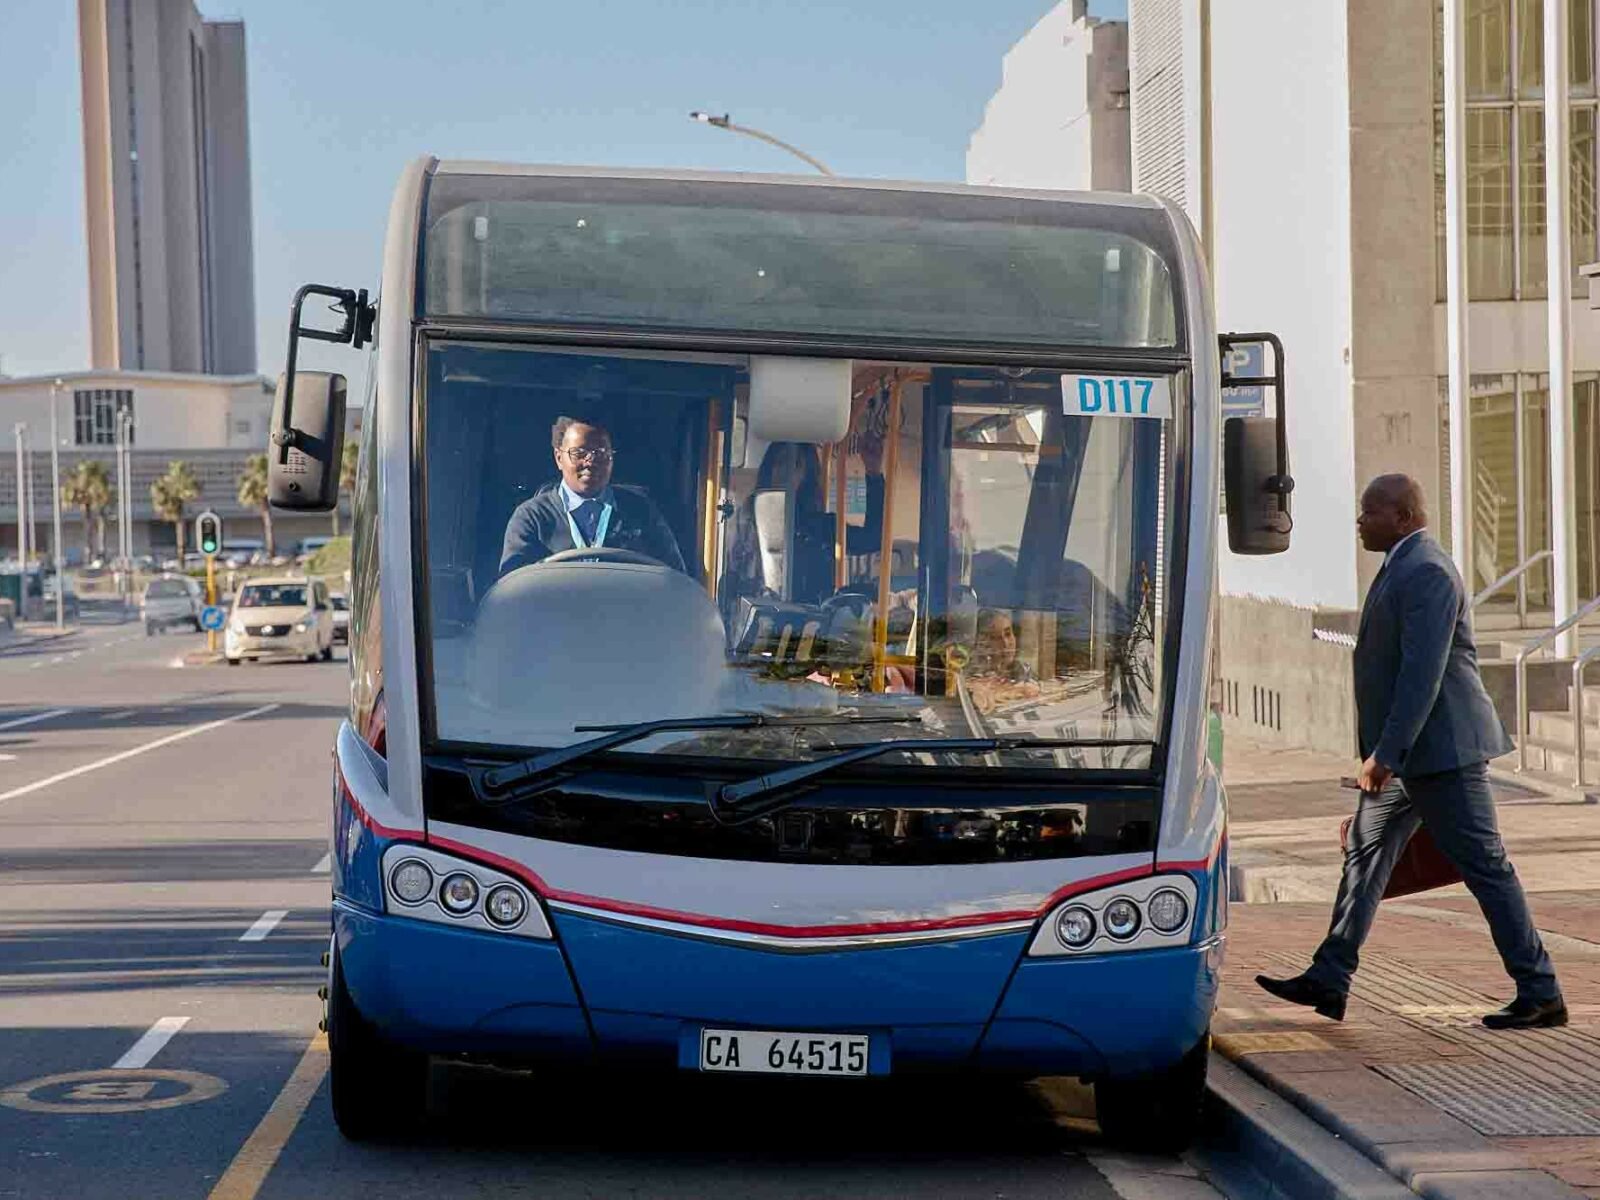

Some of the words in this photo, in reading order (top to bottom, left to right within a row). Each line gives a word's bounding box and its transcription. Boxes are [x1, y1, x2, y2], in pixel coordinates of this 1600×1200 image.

[1228, 350, 1250, 377] P
[1078, 378, 1153, 414] D117
[706, 1036, 740, 1067] CA
[768, 1039, 865, 1072] 64515
